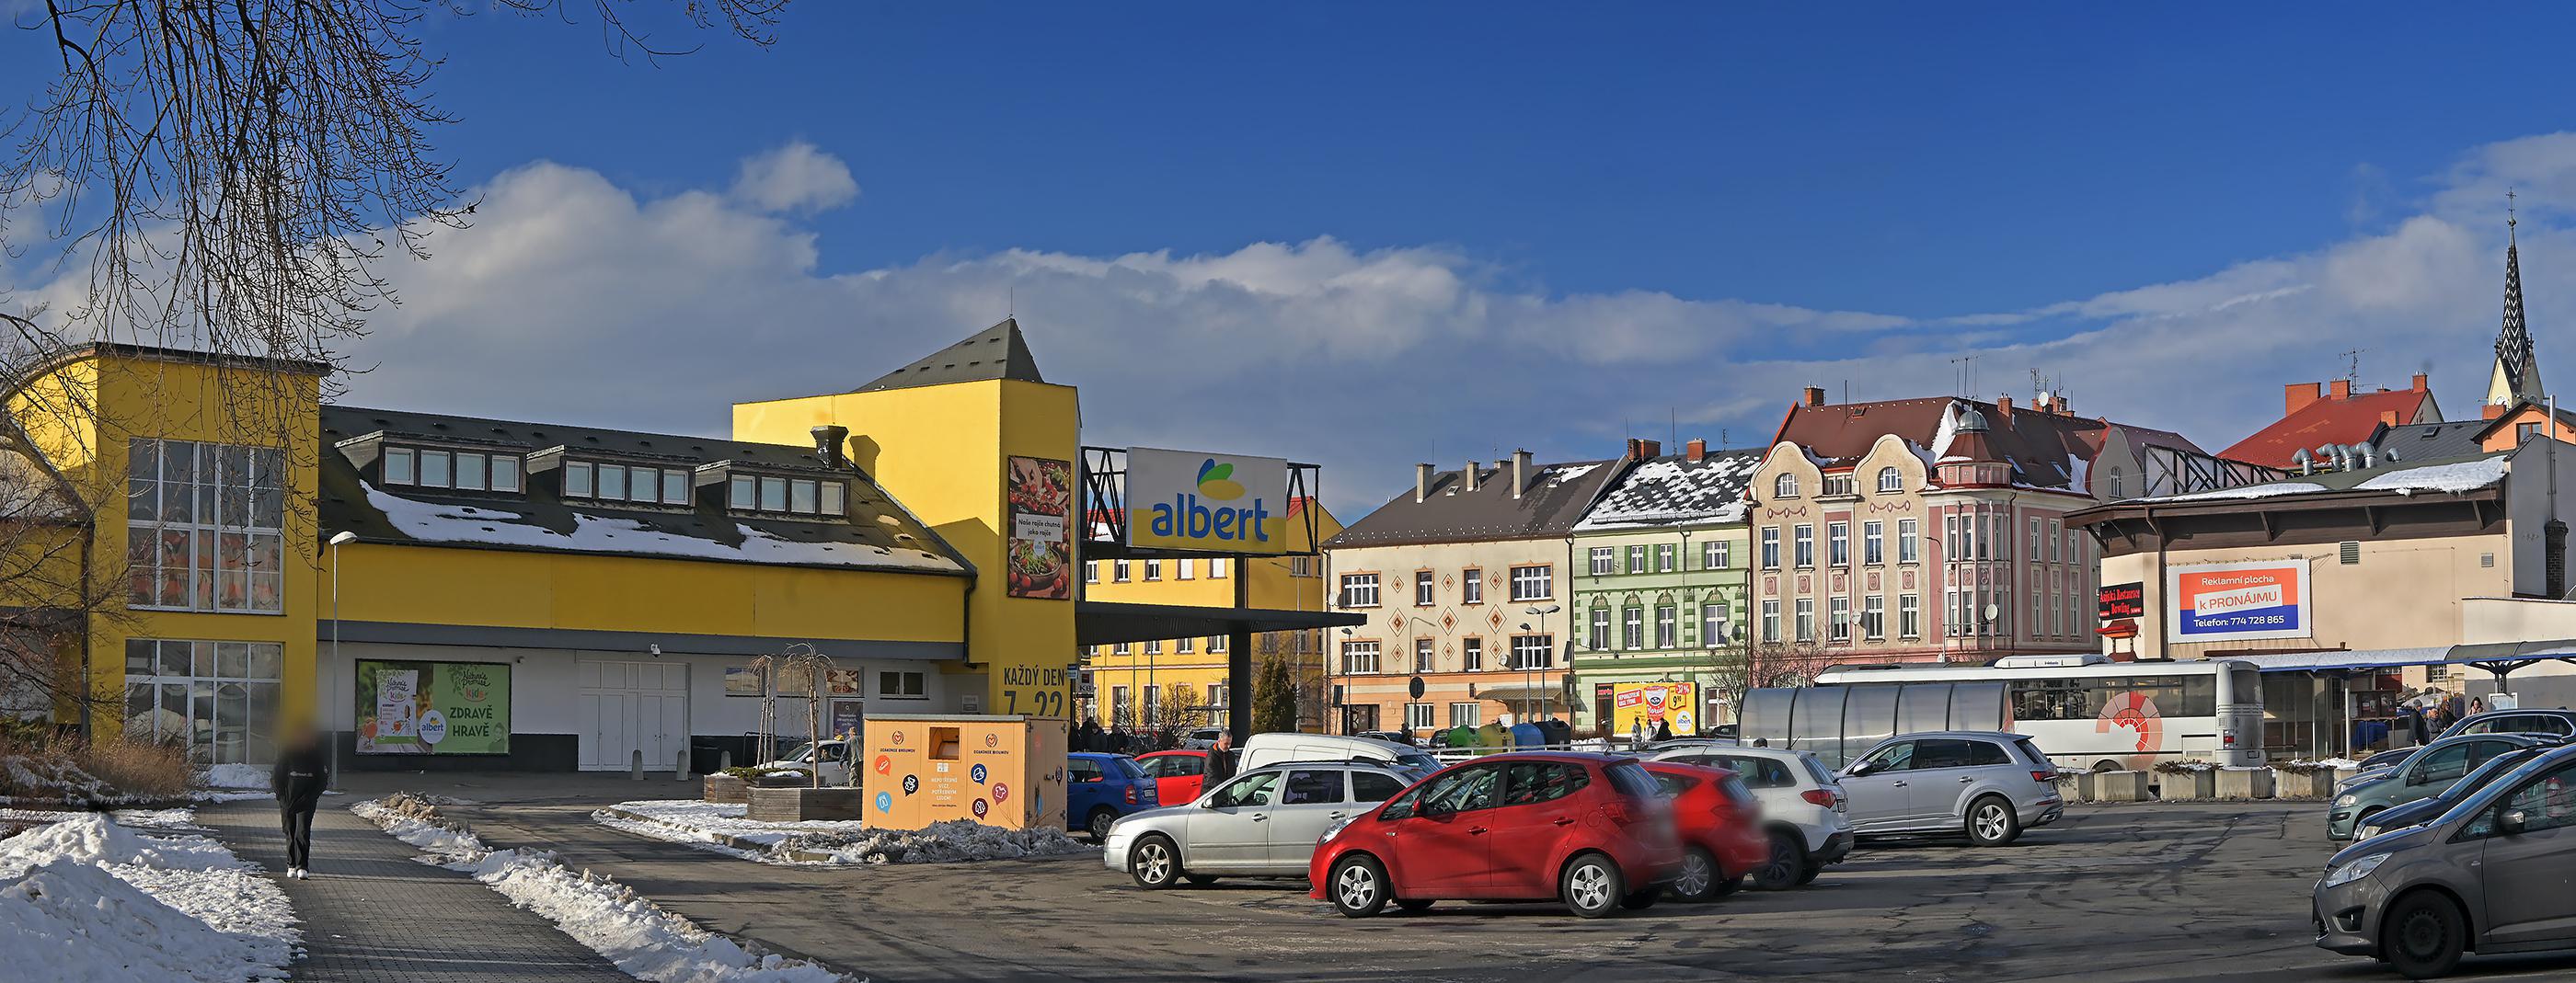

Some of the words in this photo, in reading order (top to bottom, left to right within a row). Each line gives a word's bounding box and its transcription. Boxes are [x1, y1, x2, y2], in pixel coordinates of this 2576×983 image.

[1032, 520, 1043, 528] rajče
[1151, 492, 1269, 542] albert
[2202, 576, 2243, 586] Reklamní
[2244, 575, 2274, 585] plocha
[2200, 600, 2206, 610] k
[2209, 591, 2277, 609] PRONÁJMU
[2193, 619, 2229, 627] Telefon:
[2230, 617, 2247, 625] 774
[2248, 616, 2265, 624] 728
[2267, 615, 2284, 623] 865
[1004, 664, 1040, 686] KAŽDÝ
[1043, 669, 1064, 686] DEN
[449, 704, 493, 719] ZDRAVĚ
[421, 722, 443, 732] albert
[453, 723, 489, 737] HRAVĚ
